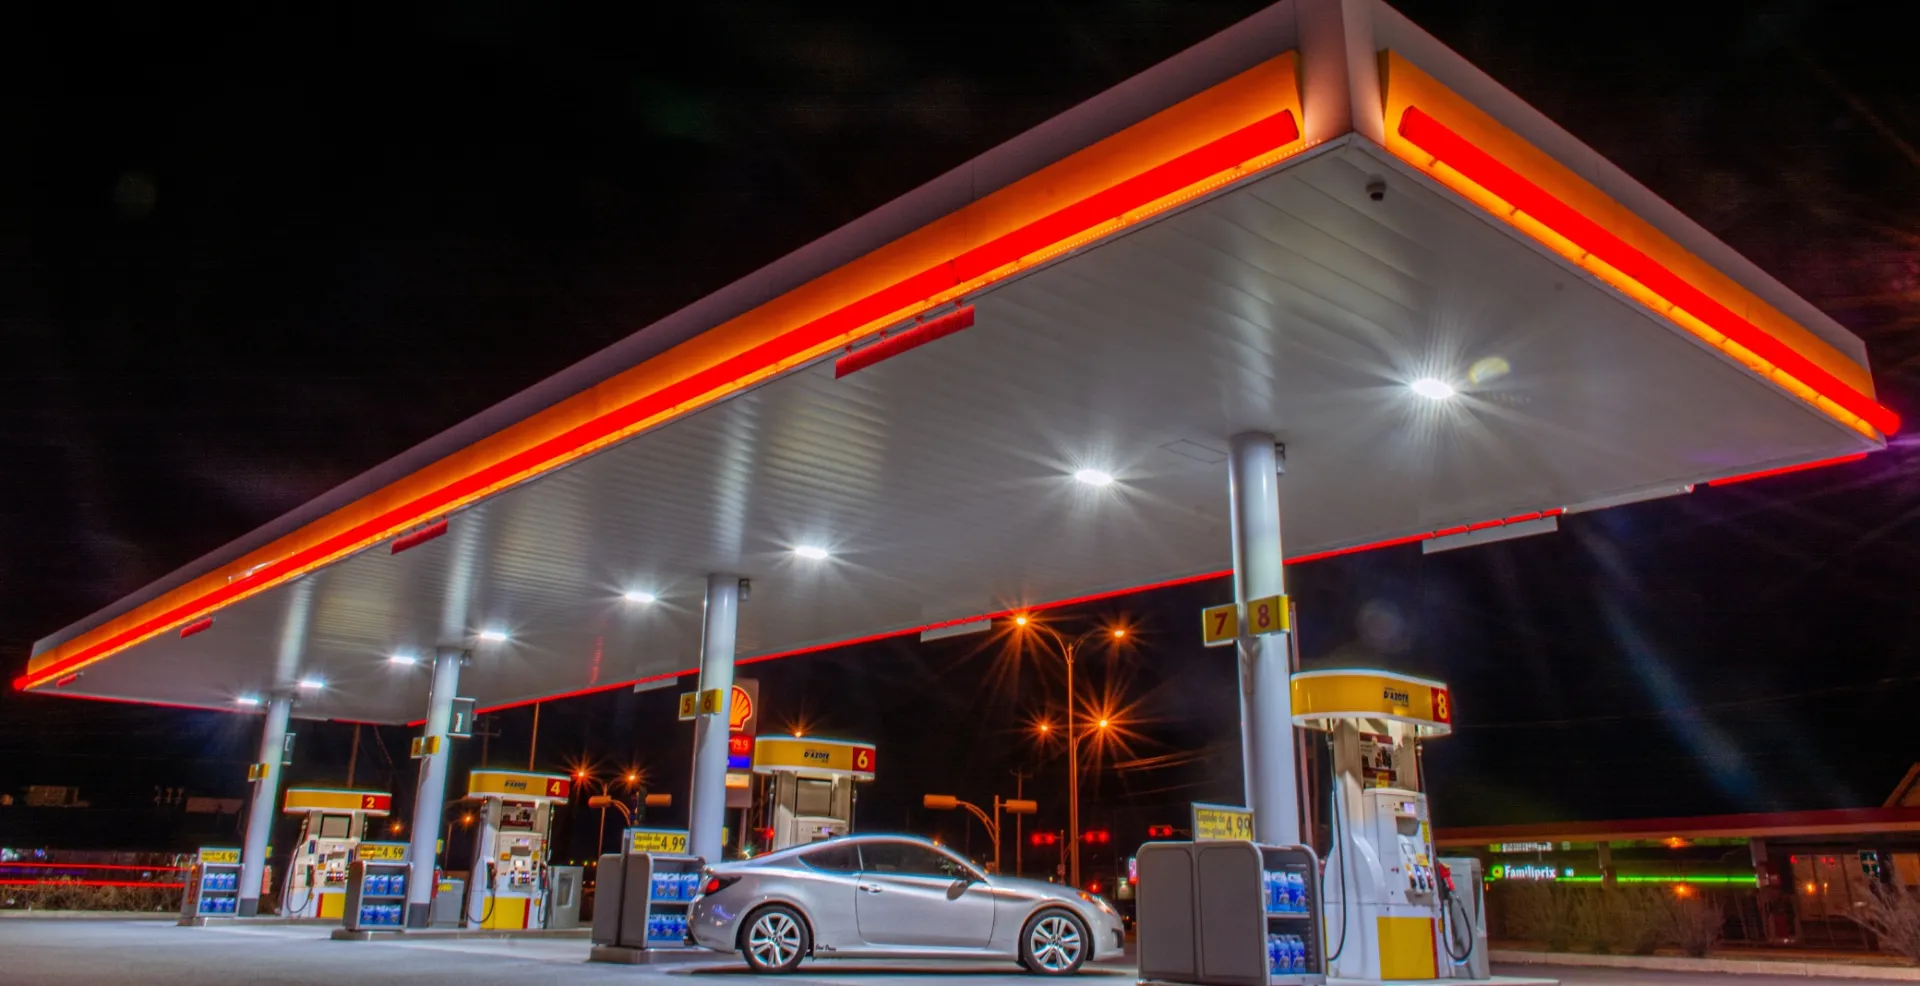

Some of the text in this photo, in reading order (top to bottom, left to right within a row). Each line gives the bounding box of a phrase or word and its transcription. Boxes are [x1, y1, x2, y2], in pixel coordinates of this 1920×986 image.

[1214, 611, 1229, 636] 7
[1257, 603, 1270, 628] 8
[684, 697, 692, 713] 5
[704, 695, 712, 712] 6
[1437, 692, 1448, 720] 8
[857, 750, 869, 769] 6
[550, 781, 561, 795] 4
[366, 796, 376, 809] 2
[660, 835, 686, 851] 4,99
[1504, 864, 1556, 881] Familiprix
